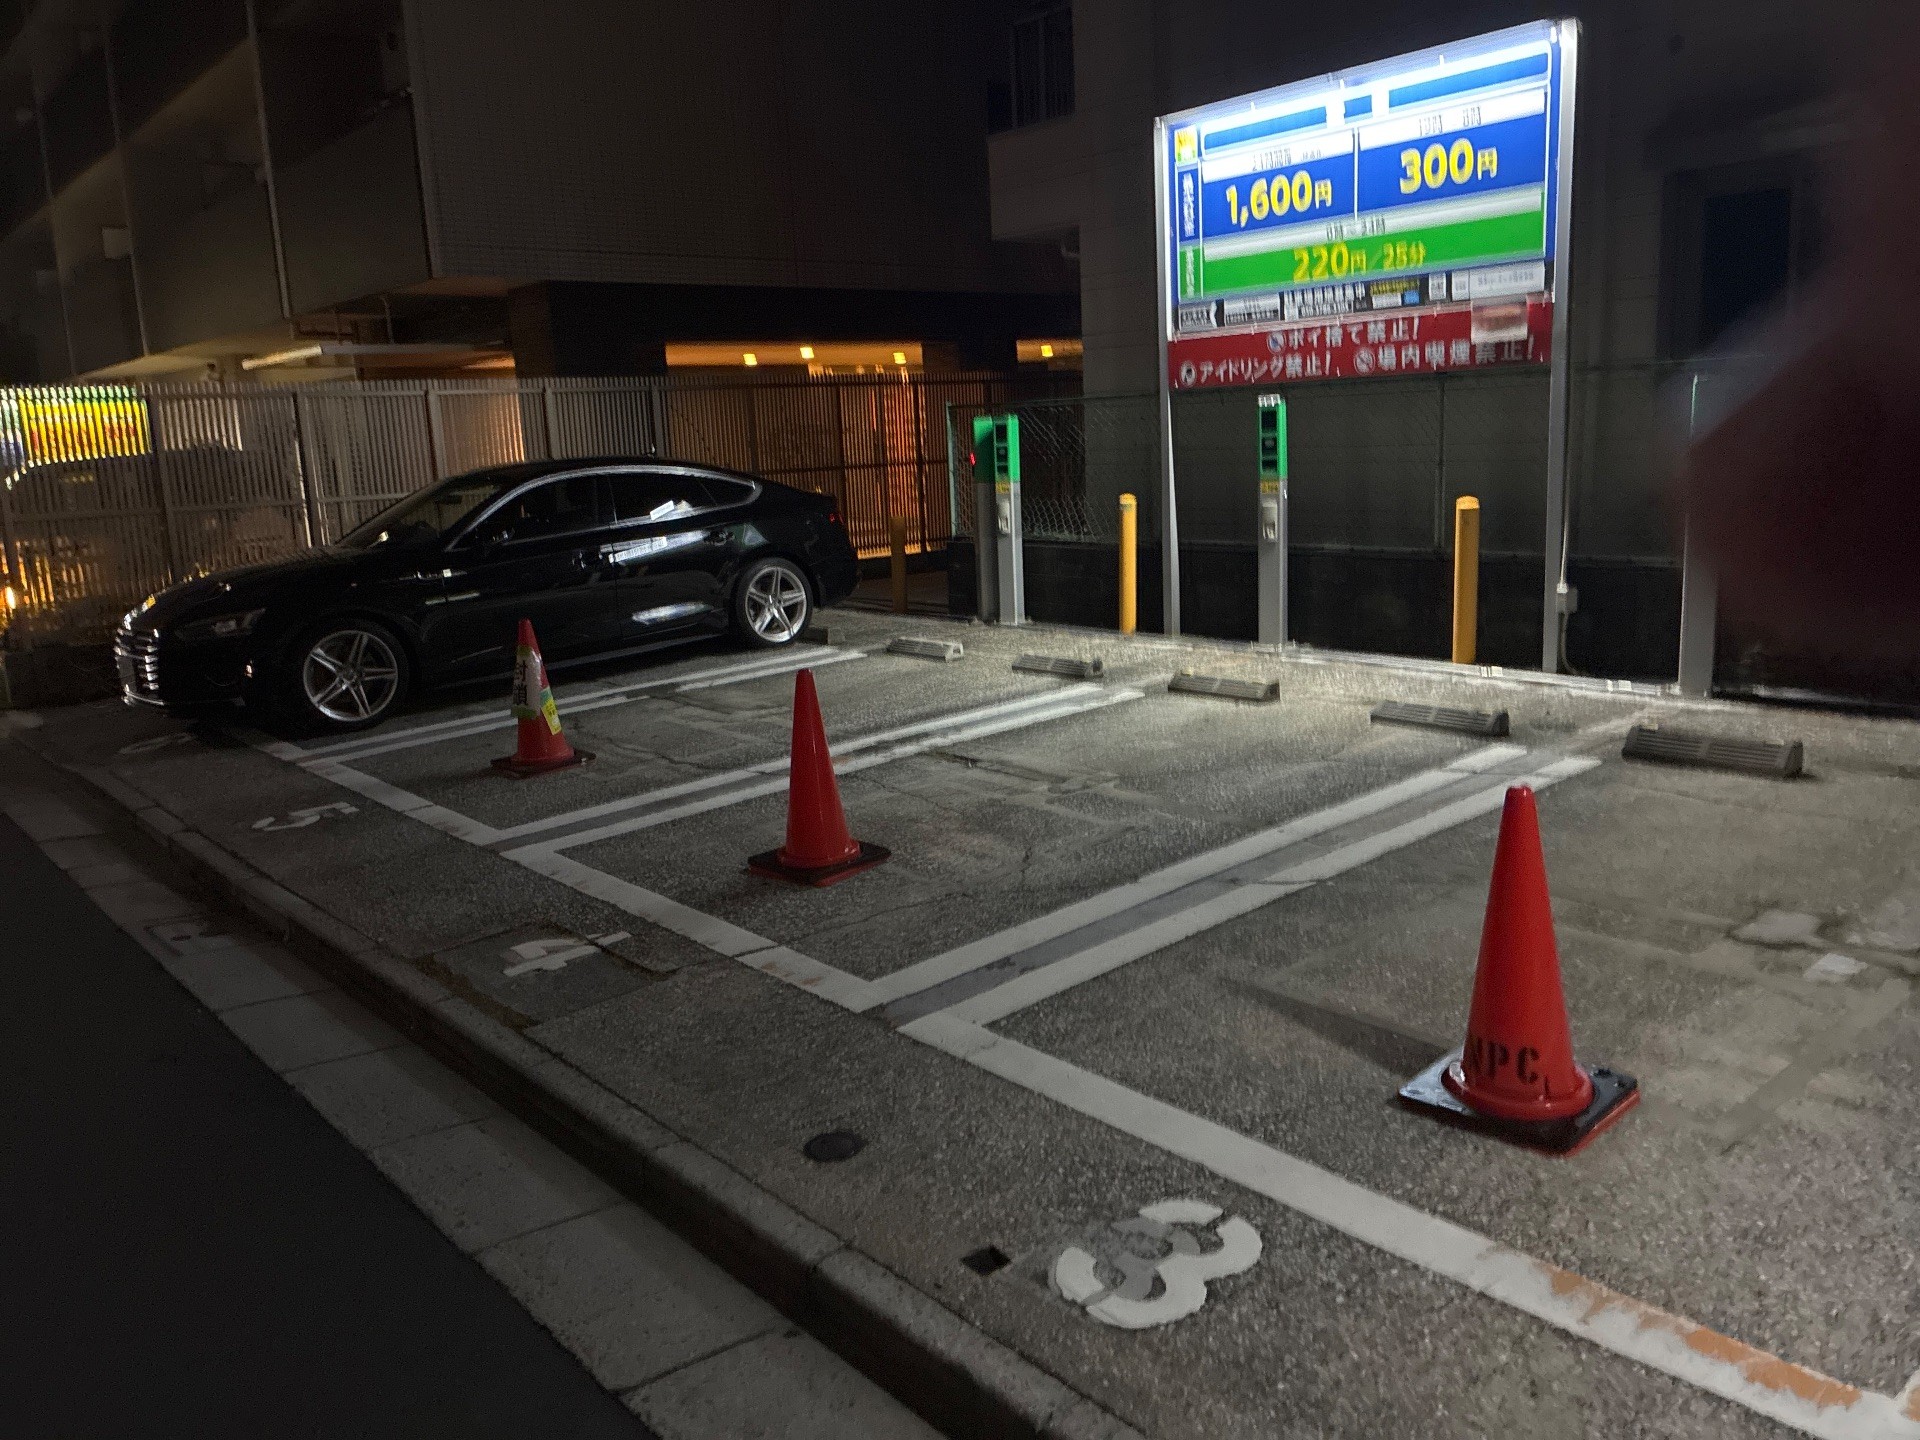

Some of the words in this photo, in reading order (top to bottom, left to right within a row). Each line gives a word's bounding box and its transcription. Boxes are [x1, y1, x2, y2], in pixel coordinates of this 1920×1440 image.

[1400, 138, 1498, 194] 300円
[1226, 170, 1332, 228] 1,600円
[502, 930, 632, 977] 4
[1055, 1199, 1263, 1329] 3
